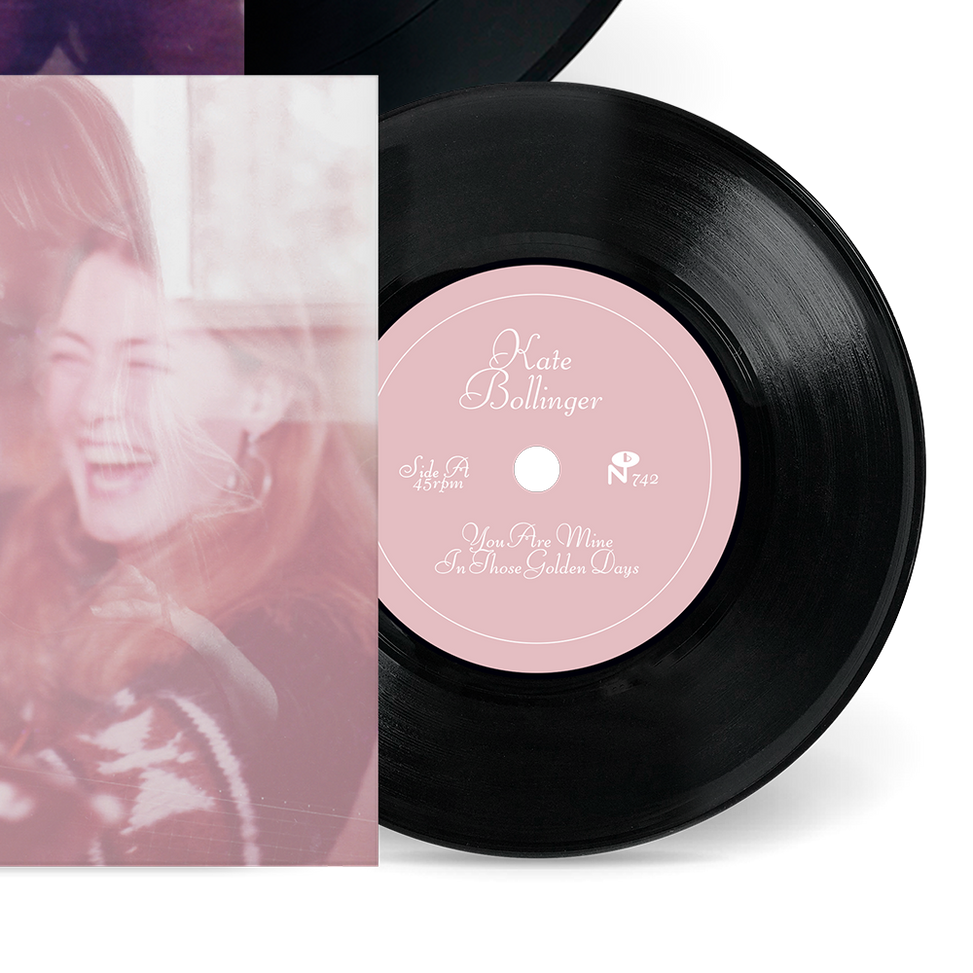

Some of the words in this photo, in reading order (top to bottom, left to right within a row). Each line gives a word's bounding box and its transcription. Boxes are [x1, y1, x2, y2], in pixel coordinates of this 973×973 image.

[489, 328, 572, 370] Kate
[459, 367, 603, 417] Bollinger
[399, 455, 439, 478] Side
[443, 455, 470, 478] A
[632, 473, 659, 487] 742
[412, 477, 464, 493] 45rpm
[462, 522, 505, 552] You
[507, 522, 552, 548] Are
[556, 523, 614, 548] Mine
[434, 548, 466, 574] In
[469, 549, 522, 574] Those
[523, 548, 587, 580] Golden
[590, 548, 640, 578] Days
